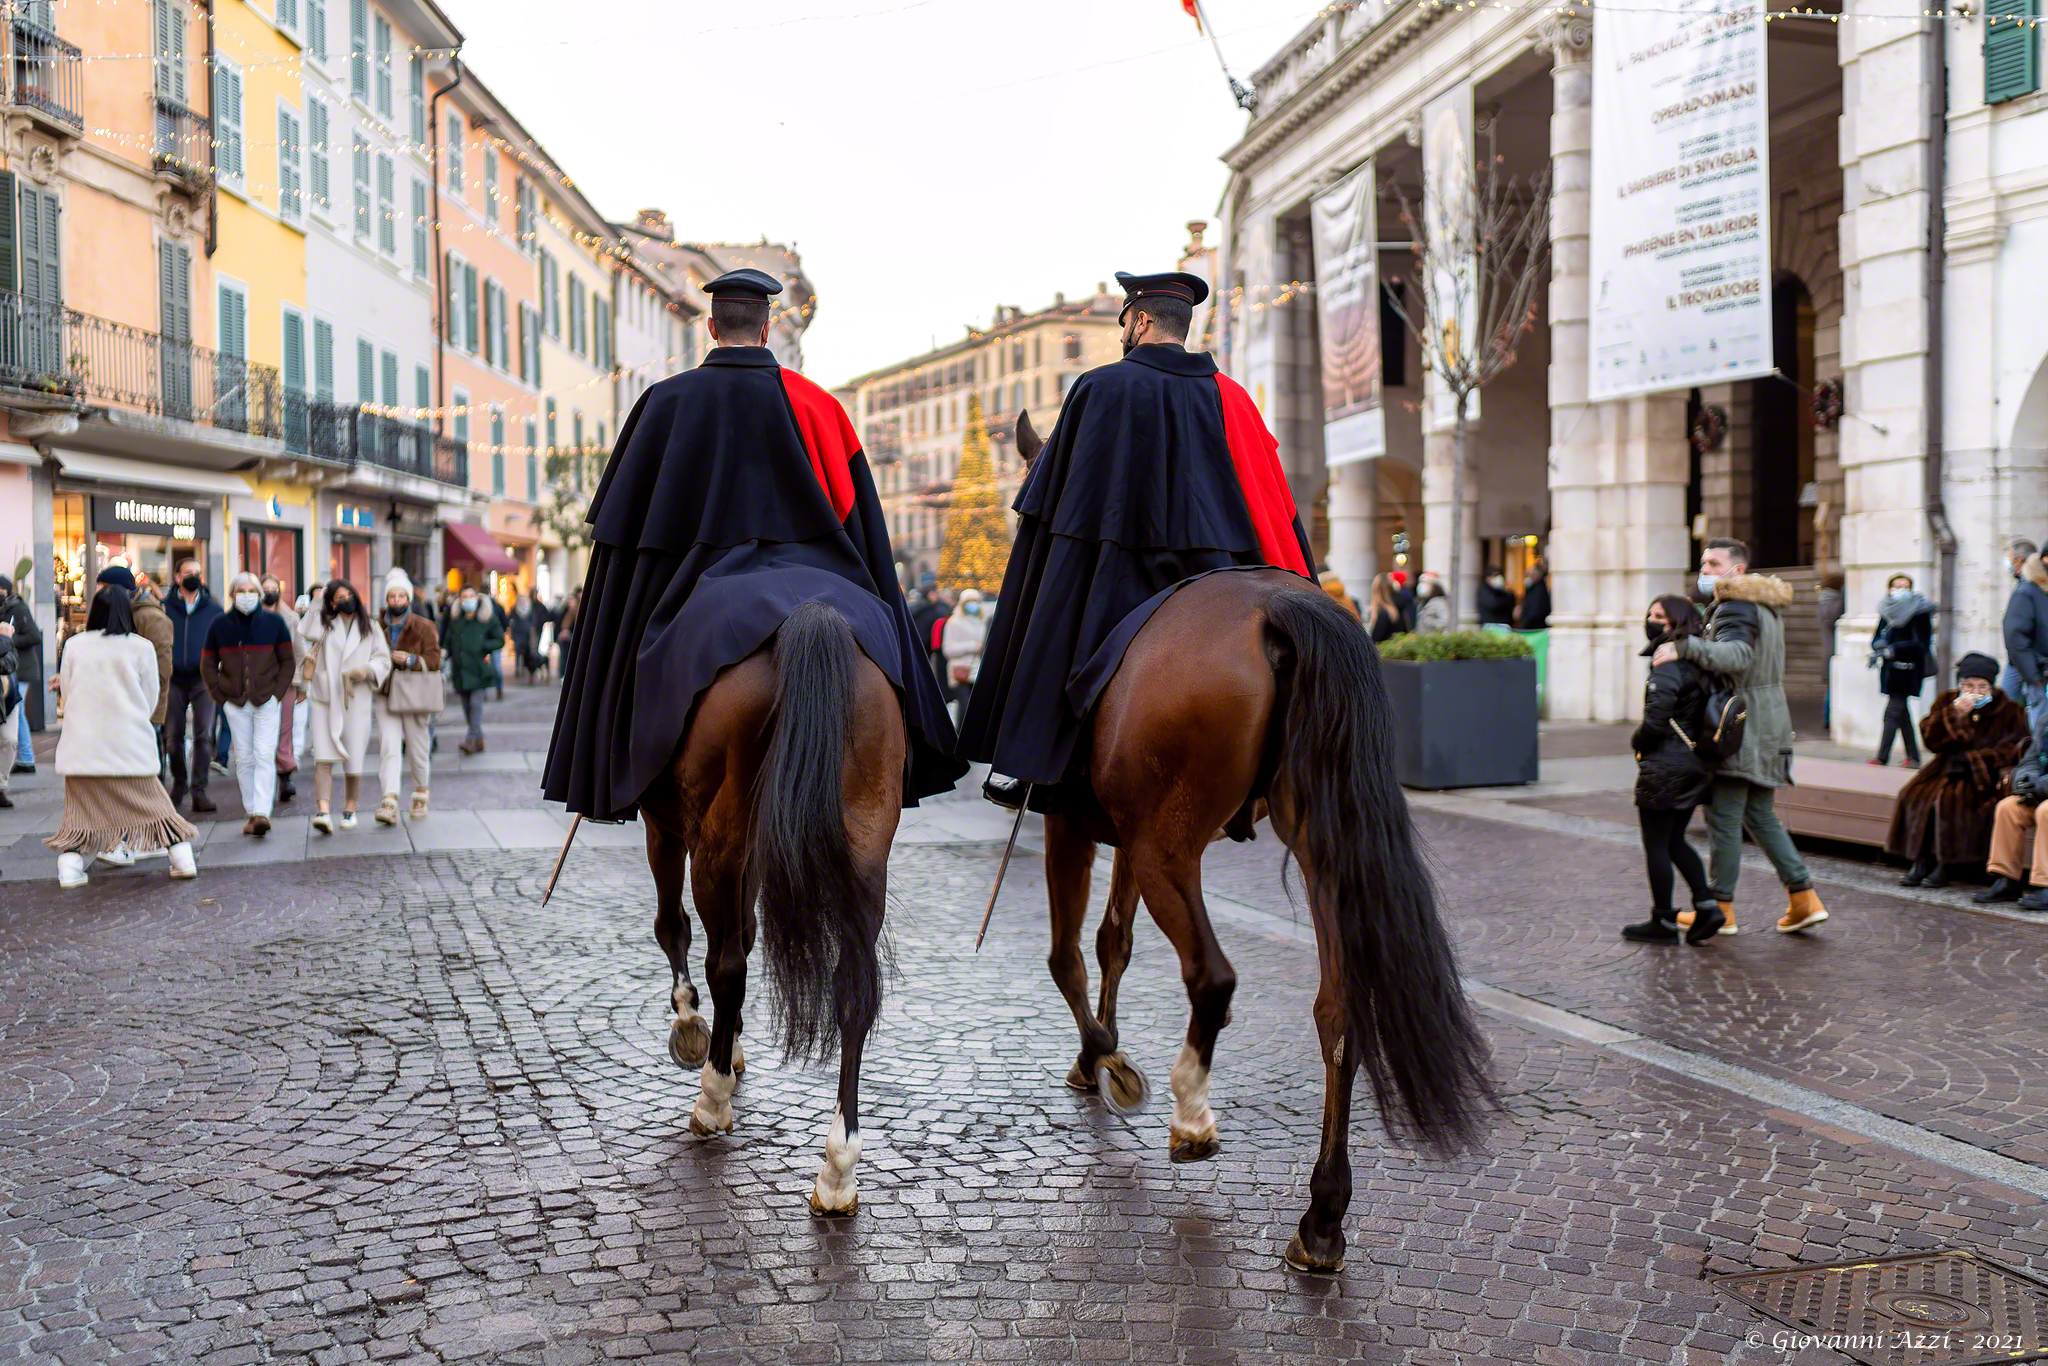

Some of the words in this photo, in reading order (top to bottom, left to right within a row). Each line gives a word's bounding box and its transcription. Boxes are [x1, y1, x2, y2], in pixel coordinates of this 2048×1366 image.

[1651, 80, 1757, 125] OPERADOMANI
[1678, 163, 1690, 179] DI
[1693, 145, 1758, 176] SIVIGLIA
[1677, 228, 1697, 244] EN
[1697, 212, 1759, 239] TAURIDE
[1666, 294, 1677, 311] IL
[1678, 277, 1761, 307] TROVATORE
